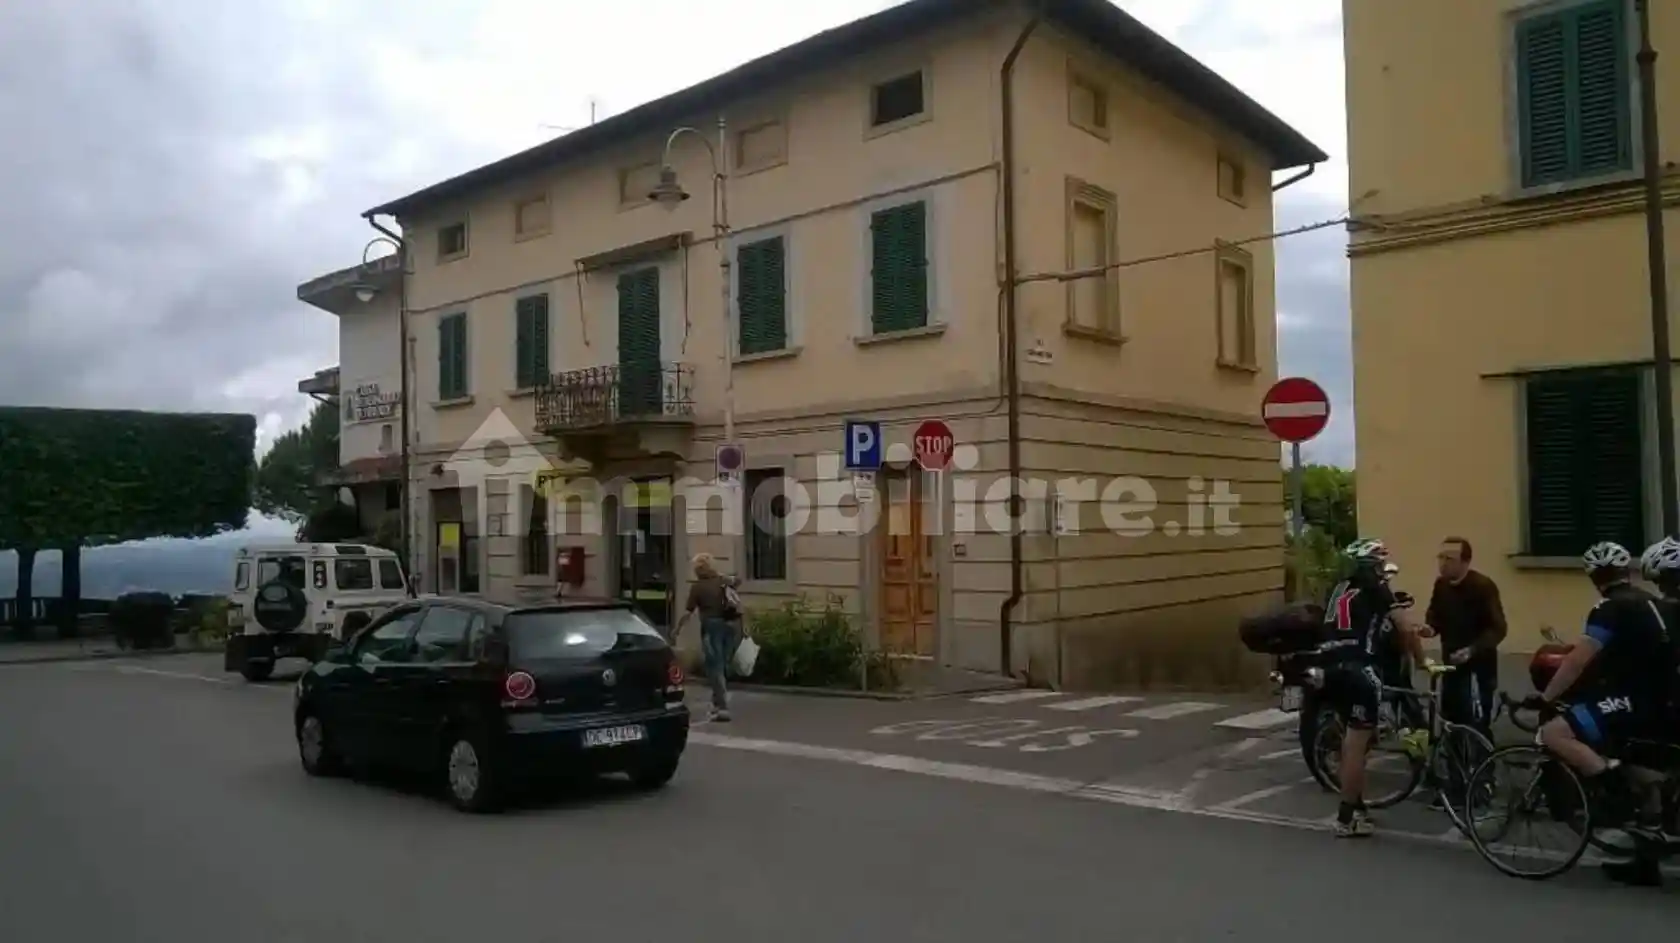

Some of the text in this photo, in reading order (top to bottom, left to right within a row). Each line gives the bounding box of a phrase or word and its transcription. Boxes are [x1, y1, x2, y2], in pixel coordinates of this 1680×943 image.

[853, 424, 874, 465] P
[916, 435, 952, 455] STOP
[1597, 696, 1632, 714] sky
